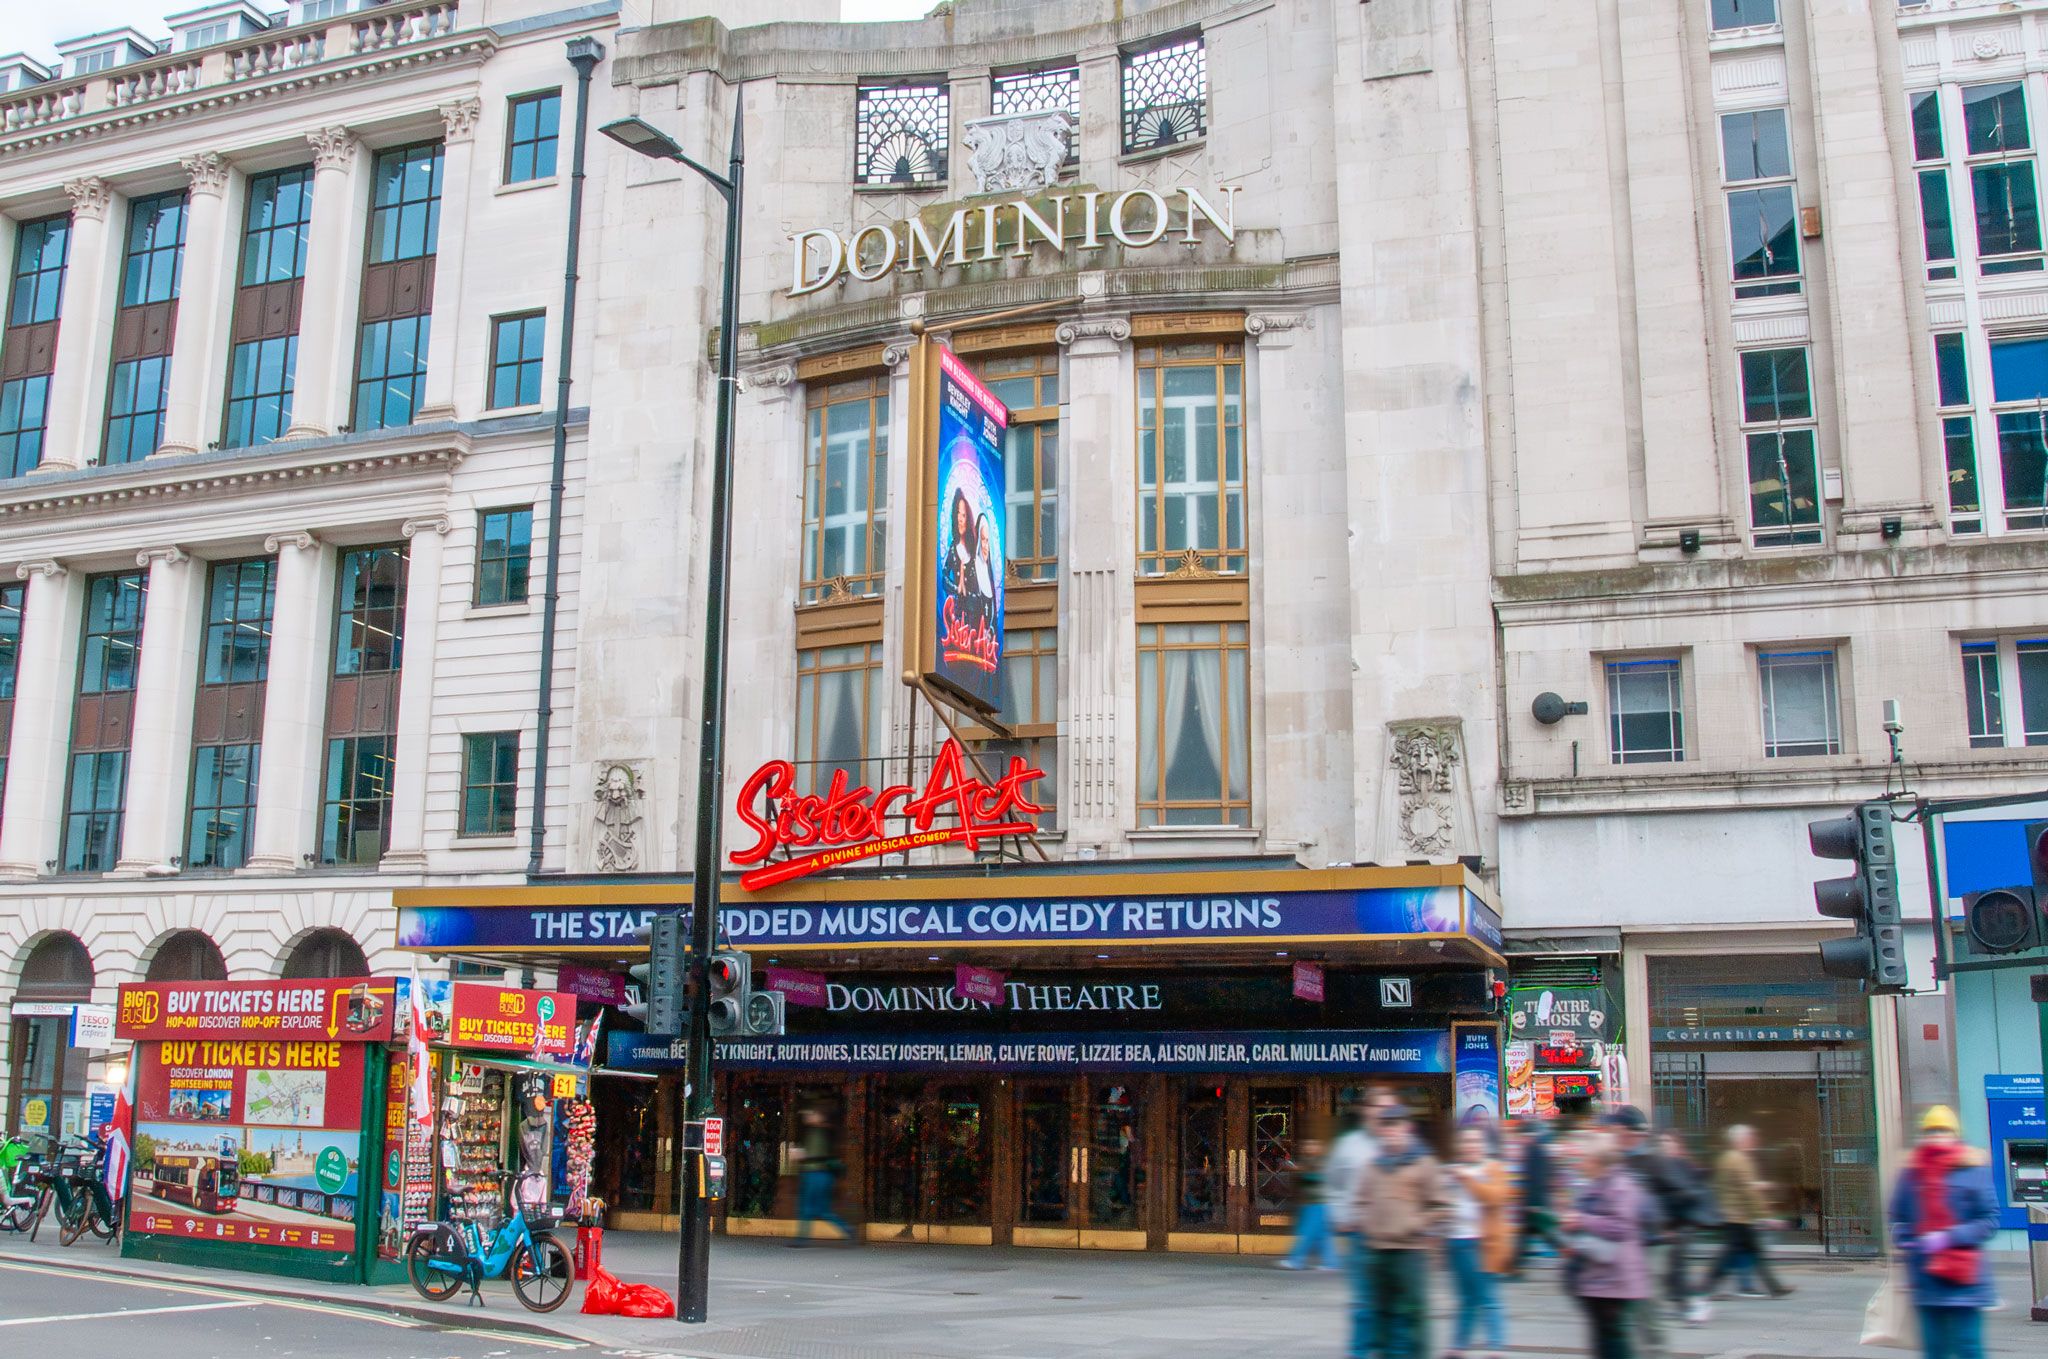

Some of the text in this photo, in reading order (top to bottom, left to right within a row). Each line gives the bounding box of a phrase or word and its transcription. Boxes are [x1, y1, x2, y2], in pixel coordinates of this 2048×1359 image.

[786, 185, 1242, 298] DOMINION
[947, 381, 971, 410] BEVERLEY
[954, 363, 975, 393] BLESSING
[975, 384, 983, 402] THE
[983, 392, 995, 412] WEST
[949, 396, 968, 420] KNIGHT
[984, 416, 997, 436] RUTH
[983, 427, 997, 448] JONES
[941, 595, 999, 671] Sister Act
[729, 737, 1046, 865] Sister Act
[811, 831, 951, 868] A DIVINE MUSICAL COMEDY
[531, 912, 583, 938] THE
[818, 906, 963, 937] MUSICAL
[967, 902, 1116, 934] COMEDY
[1122, 899, 1281, 931] RETURNS
[124, 991, 144, 1008] BIG
[166, 989, 326, 1014] BUY TICKETS HERE
[500, 992, 514, 1004] BIG
[1004, 982, 1163, 1011] THEATRE
[499, 1002, 514, 1013] BUS
[1525, 1000, 1590, 1013] THATRE
[82, 1015, 109, 1025] TESCO
[122, 1008, 142, 1024] BUS
[165, 1015, 322, 1029] HOP-ON DISCOVER HOP-OFF EXPLORE
[81, 1029, 107, 1039] express
[459, 1017, 567, 1039] BUY TICKETS ERE
[1666, 1028, 1854, 1041] Corinthian House
[459, 1032, 566, 1048] HOP-ON DISCOVER HOP-O XPLORE
[1464, 1042, 1489, 1050] JONES
[1465, 1034, 1488, 1042] RUTH
[160, 1042, 341, 1068] BUY TICKETS HERE
[632, 1043, 1421, 1064] STARRING BEEY KNIGHT, RUTH JONES, LESLEY JOSEPH, LEMAR, CLIVE ROWE, LIZZIE BEA, ALISON JIEAR, CARL MULLANEY AND MORE!
[1605, 1043, 1624, 1051] HOT
[170, 1067, 234, 1079] DISCOVER LONDON
[170, 1079, 233, 1090] SIGHTSEEING TOUR
[706, 1121, 720, 1130] LOOK
[706, 1132, 720, 1140] BOTH
